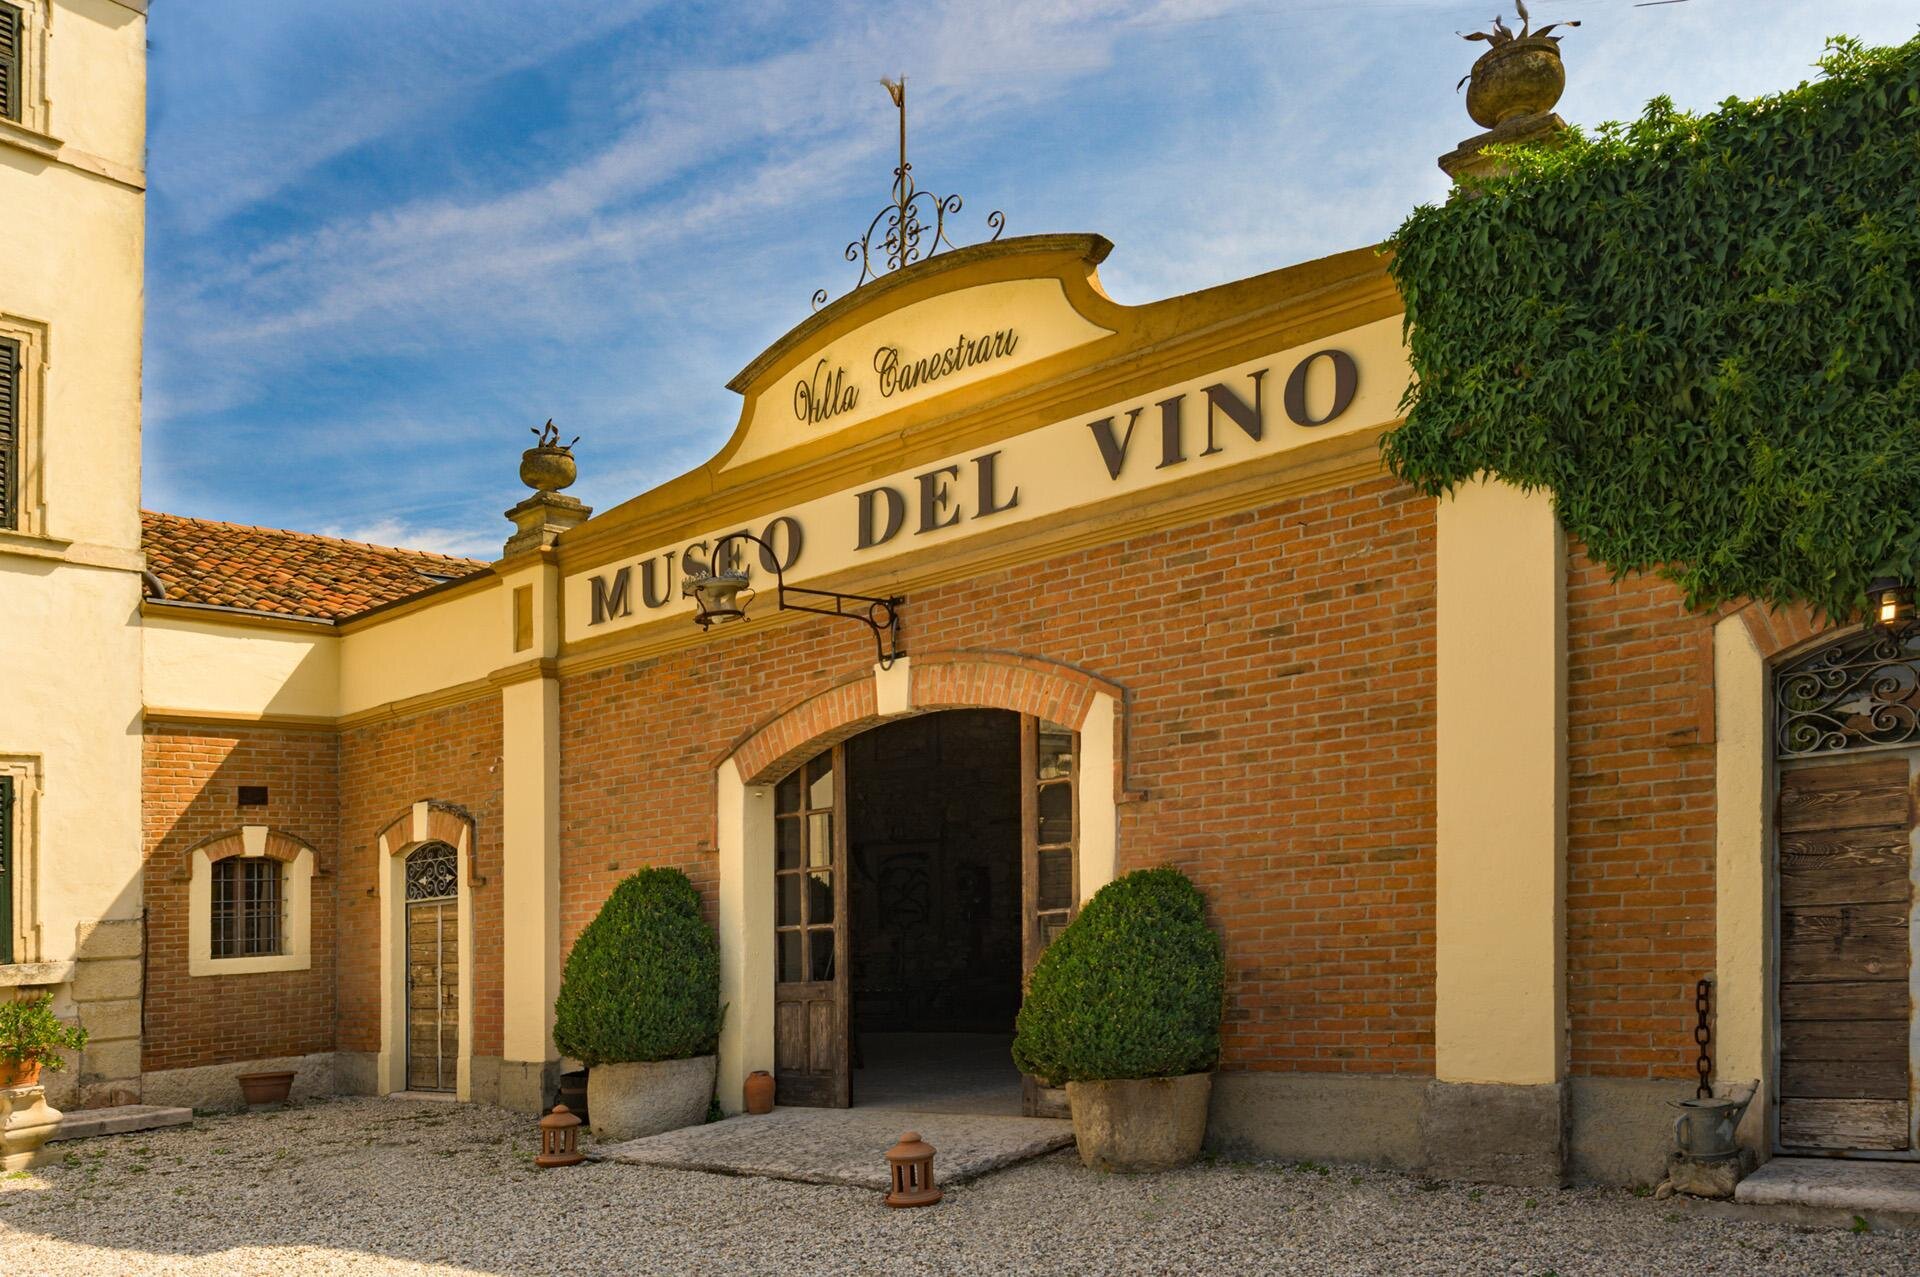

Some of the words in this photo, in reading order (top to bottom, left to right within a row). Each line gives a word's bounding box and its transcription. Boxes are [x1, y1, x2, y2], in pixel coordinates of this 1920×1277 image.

[794, 358, 860, 426] Villa
[873, 328, 1019, 398] Canestrari
[853, 450, 1019, 552] DEL
[1087, 349, 1359, 481] VINO
